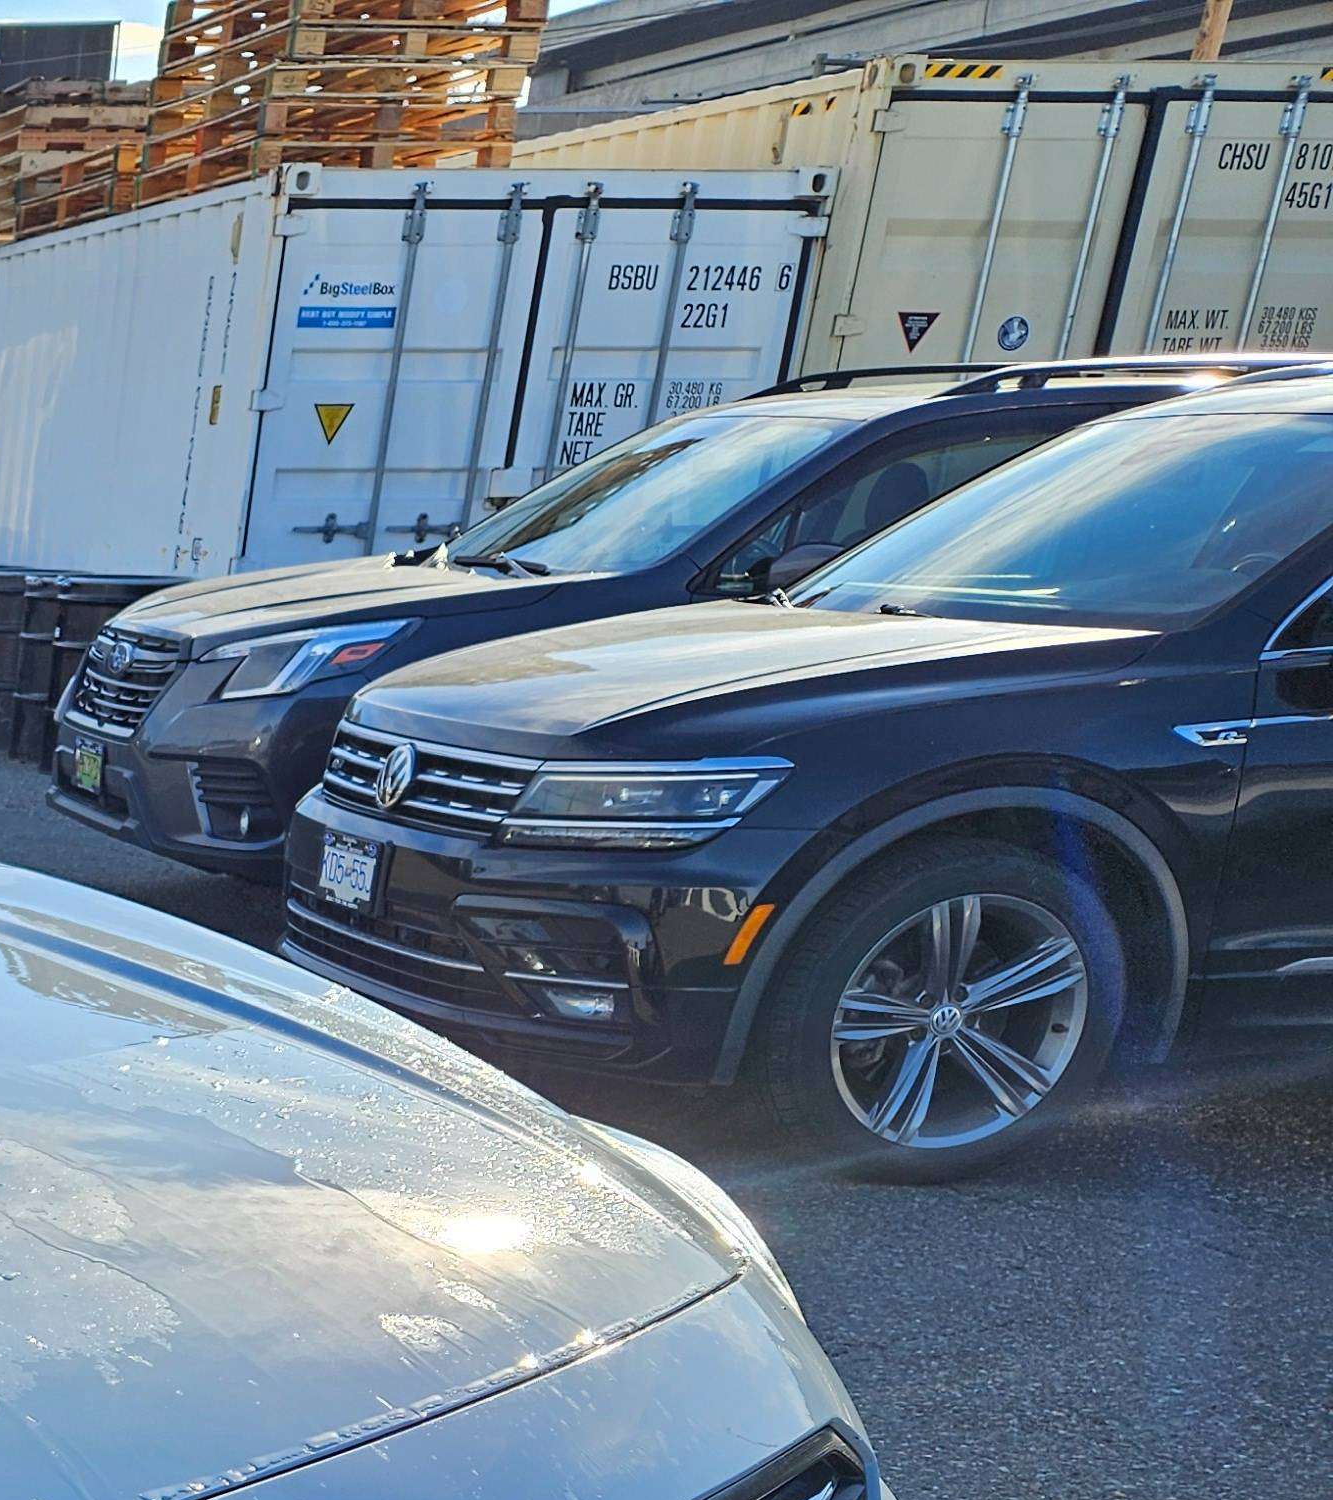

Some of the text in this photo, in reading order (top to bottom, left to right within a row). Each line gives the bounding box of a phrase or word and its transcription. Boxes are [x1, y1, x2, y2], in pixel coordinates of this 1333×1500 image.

[1218, 143, 1333, 171] CHSU 810
[320, 282, 395, 297] BigSteelBox
[608, 265, 792, 291] BSBU 212446 6
[680, 303, 729, 329] 22G1
[1165, 310, 1200, 330] MAX.
[570, 382, 608, 408] MAX.
[613, 383, 638, 408] GR.
[567, 412, 606, 436] TARE
[559, 441, 594, 465] NET
